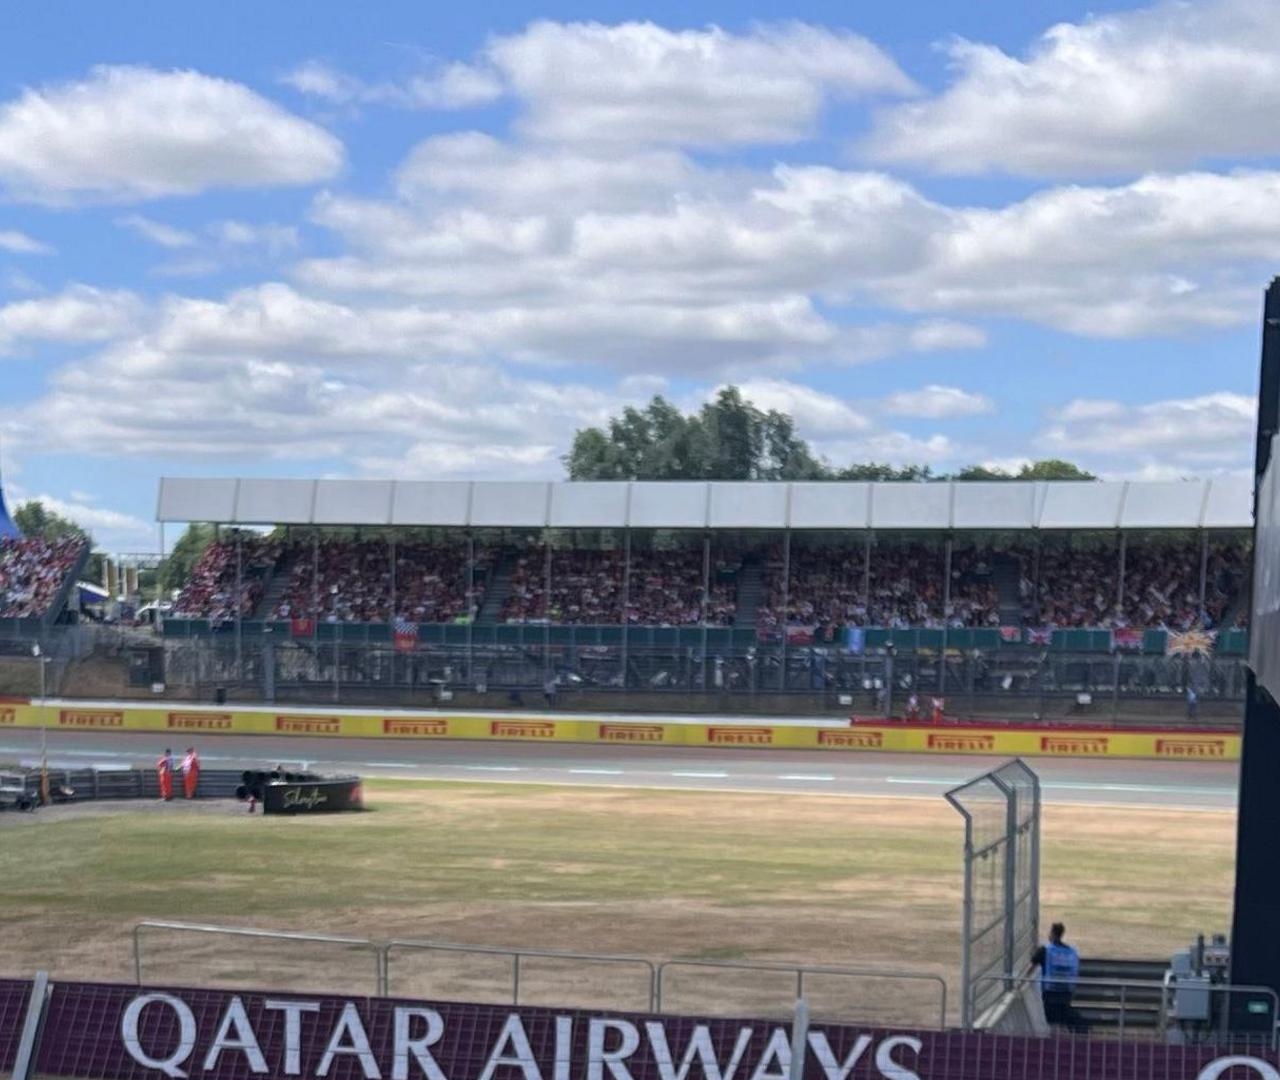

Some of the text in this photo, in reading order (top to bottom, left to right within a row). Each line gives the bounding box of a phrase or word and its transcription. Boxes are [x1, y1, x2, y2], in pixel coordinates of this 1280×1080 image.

[60, 710, 123, 726] PIRELLI
[168, 713, 231, 729] PIRELLI
[276, 716, 339, 732] PIRELLI
[383, 719, 447, 735] PIRELLI
[491, 721, 555, 737] PIRELLI
[599, 724, 663, 741] PIRELLI
[708, 728, 772, 744] PIRELLI
[818, 730, 883, 747] PIRELLI
[928, 734, 994, 750] PIRELLI
[1041, 736, 1108, 753] PIRELLI
[1156, 739, 1224, 756] PIRELLI
